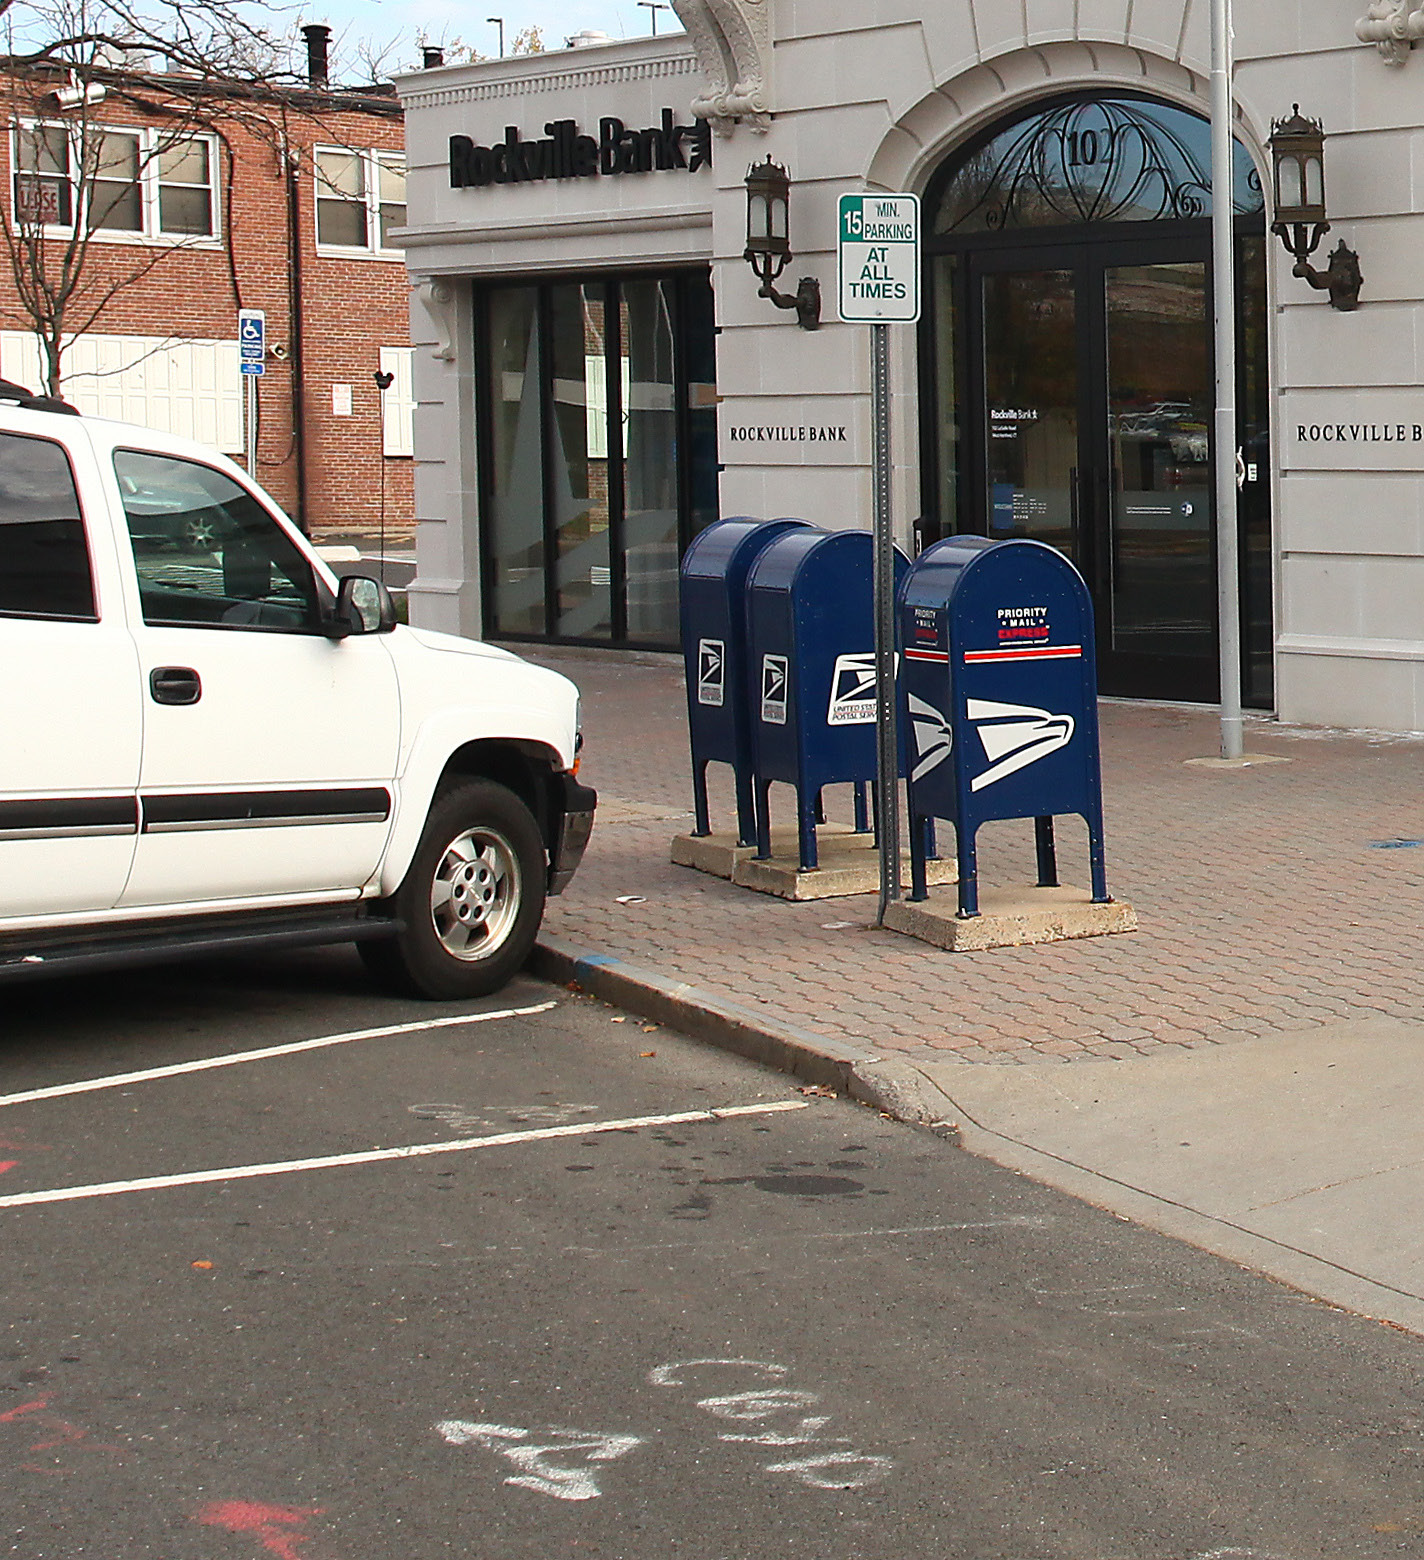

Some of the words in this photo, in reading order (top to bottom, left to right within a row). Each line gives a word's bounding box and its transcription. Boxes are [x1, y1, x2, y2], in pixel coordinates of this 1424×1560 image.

[449, 119, 598, 189] Rockville
[599, 107, 688, 175] Bank
[844, 210, 863, 235] 15
[876, 202, 900, 218] MIN.
[864, 223, 913, 239] PARKING
[867, 247, 889, 263] AT
[860, 265, 894, 280] ALL
[848, 282, 907, 299] TIMES
[730, 426, 805, 441] ROCKVILLE
[809, 426, 847, 441] BANK
[1296, 424, 1406, 441] ROCKVILLE
[997, 607, 1047, 618] PRIORITY
[1010, 618, 1036, 627] MAIL
[833, 703, 860, 713] UNITED
[861, 702, 877, 711] STAT
